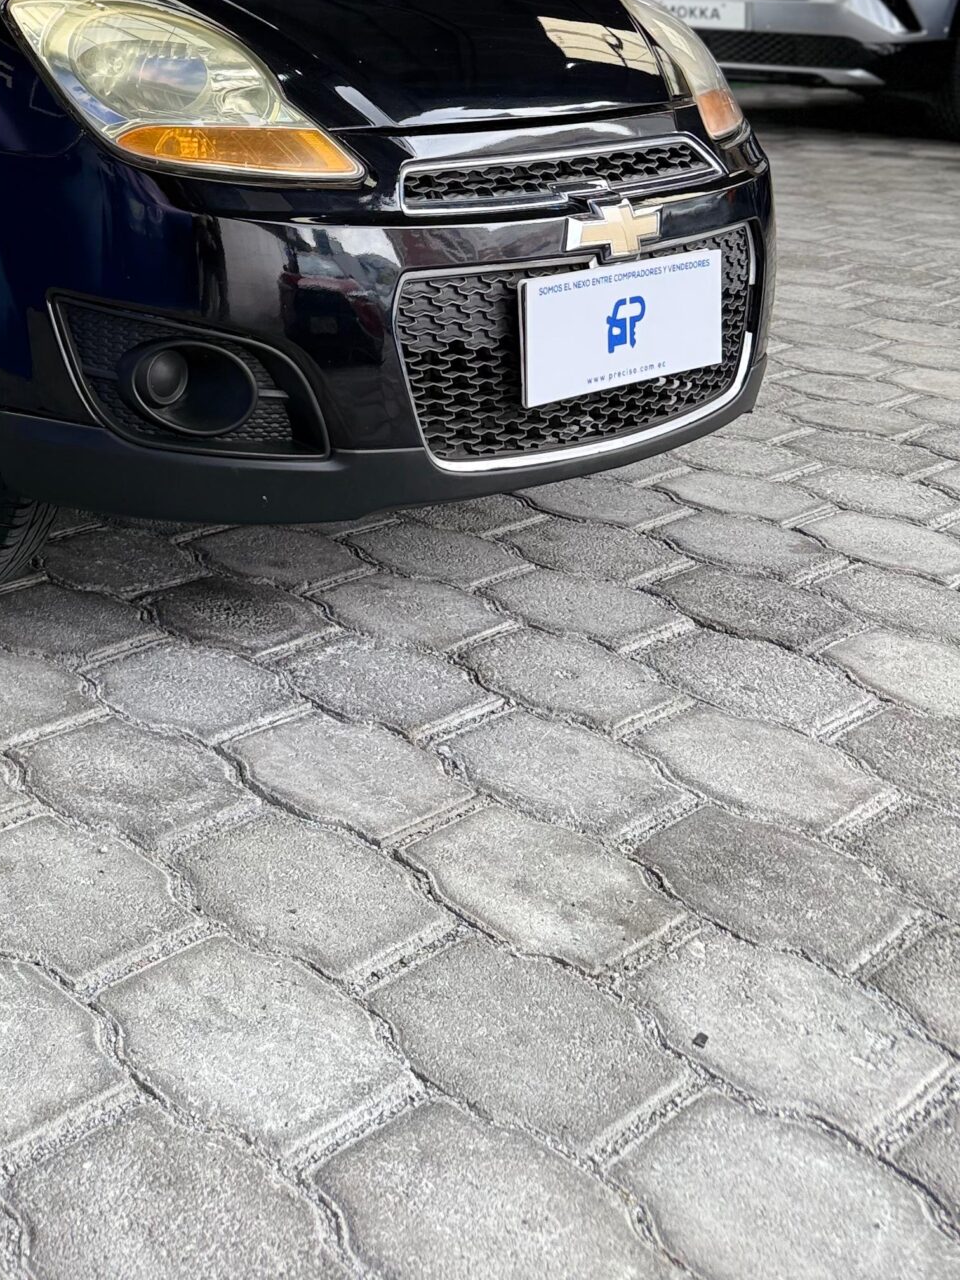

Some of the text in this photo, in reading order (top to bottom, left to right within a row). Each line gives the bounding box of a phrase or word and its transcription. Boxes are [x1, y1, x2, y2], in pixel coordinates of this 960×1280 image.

[538, 259, 711, 296] SOMOS EL NEXO ENTRE COMPRADORES Y VENDEDORES
